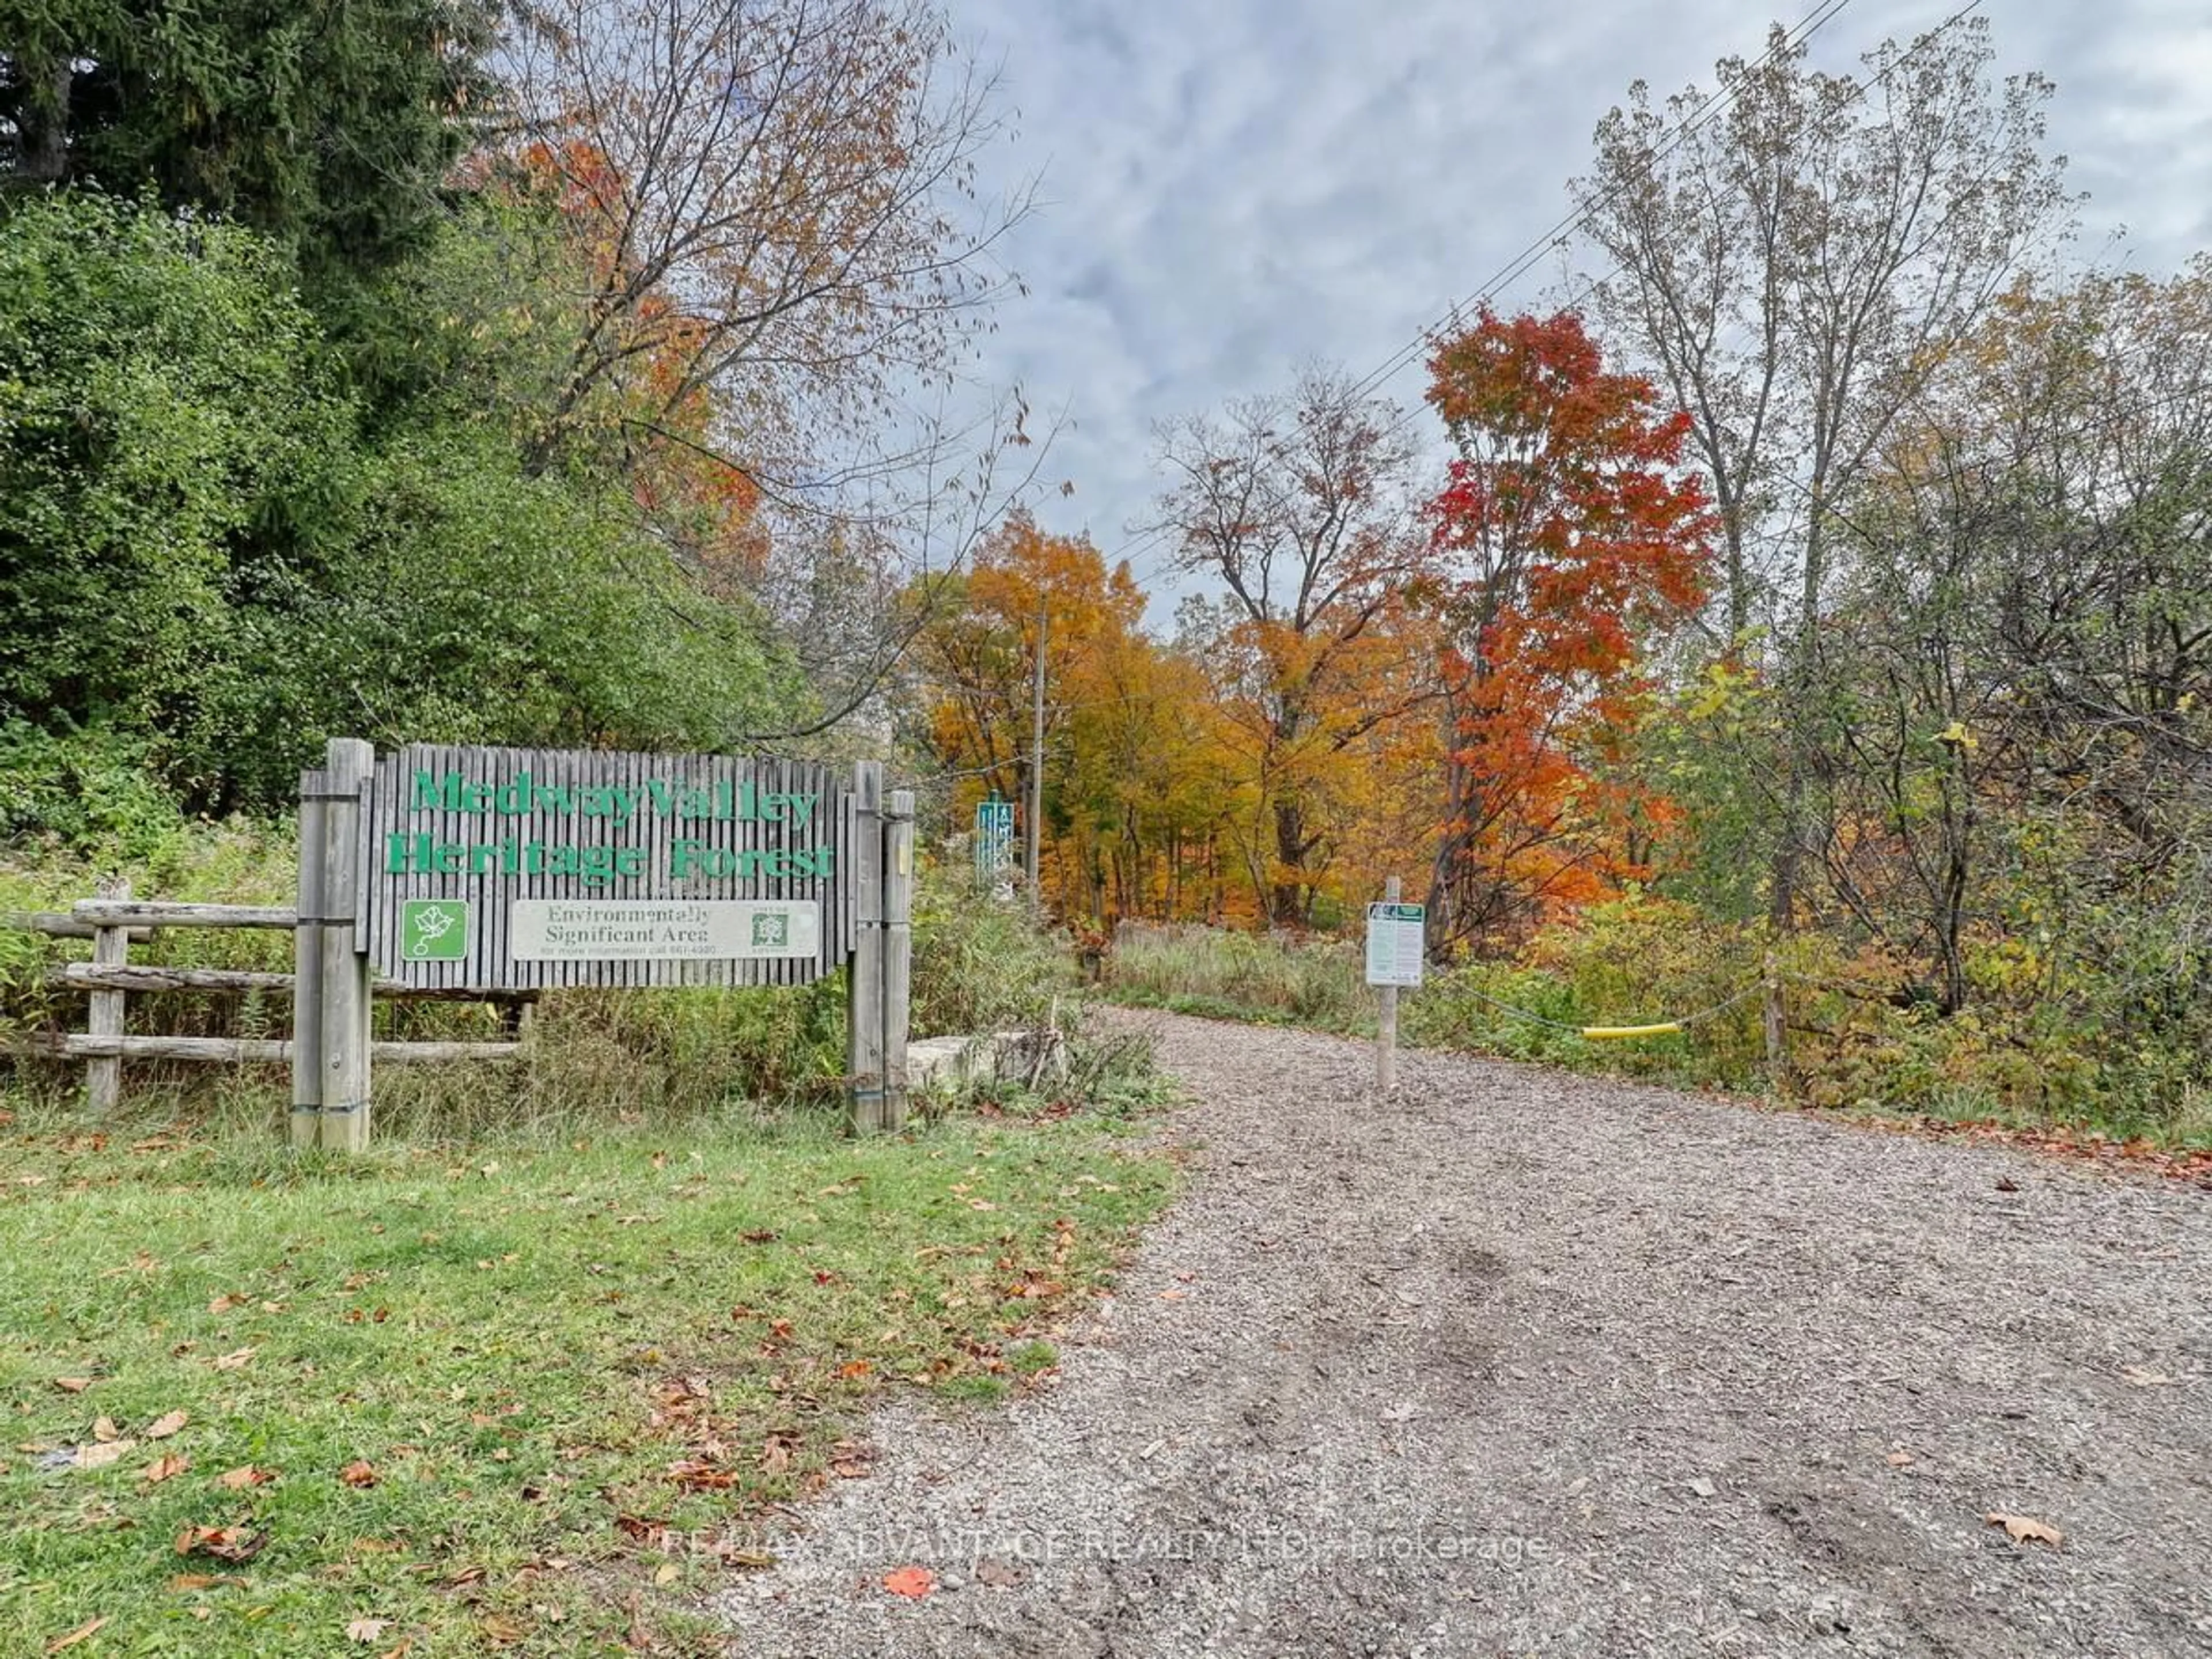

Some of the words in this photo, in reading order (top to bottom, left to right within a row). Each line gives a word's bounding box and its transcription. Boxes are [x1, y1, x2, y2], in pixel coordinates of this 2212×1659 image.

[410, 767, 643, 827] Medway
[646, 779, 819, 831] Valley
[386, 832, 647, 887] Heritage
[671, 839, 834, 878] Forest
[548, 905, 709, 926] Environmentally
[546, 926, 654, 945] Significant
[662, 927, 709, 942] Area
